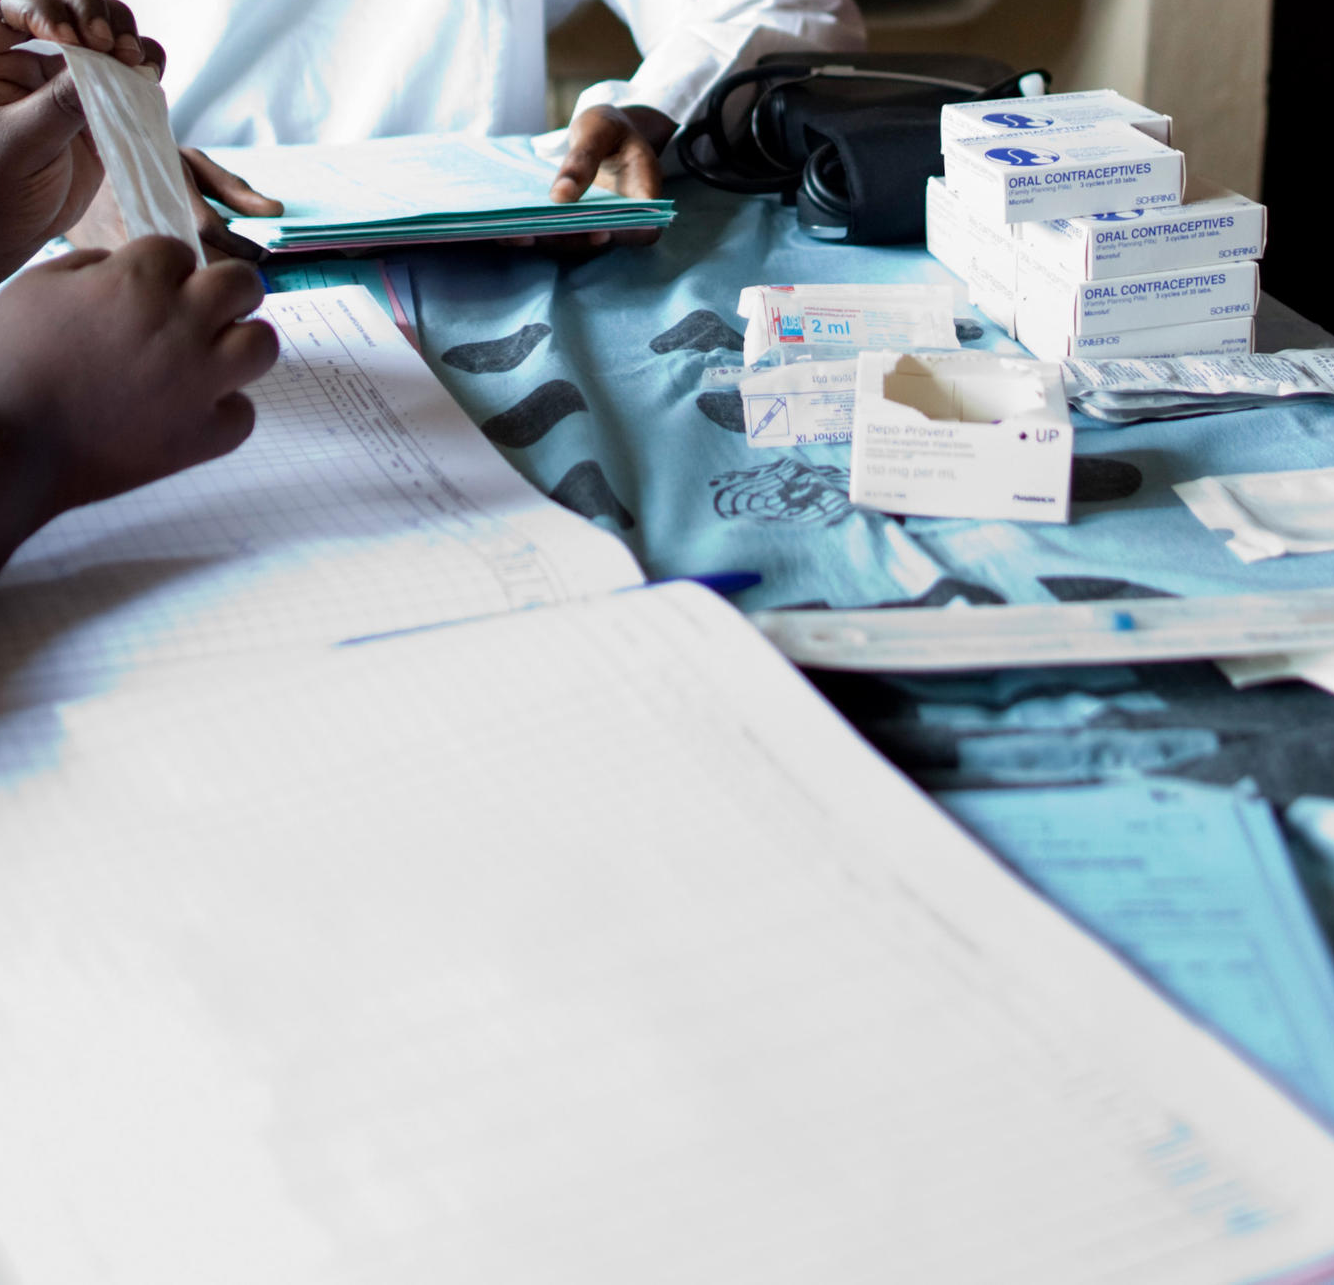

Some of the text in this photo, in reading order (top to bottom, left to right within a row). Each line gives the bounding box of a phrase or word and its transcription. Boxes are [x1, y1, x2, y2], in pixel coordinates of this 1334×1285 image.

[1008, 162, 1152, 189] ORAL CONTRACEPTIVES
[1135, 193, 1176, 205] SCHERING
[1096, 230, 1130, 243] ORAL
[1131, 216, 1234, 239] CONTRACEPTIVES
[1218, 246, 1258, 259] SCHERING
[1084, 273, 1226, 300] ORAL CONTRACEPTIVES
[1210, 304, 1250, 315] SCHERING
[811, 319, 822, 334] 2
[827, 320, 851, 336] ml
[1077, 336, 1120, 348] SCHERING
[1034, 429, 1060, 443] UP
